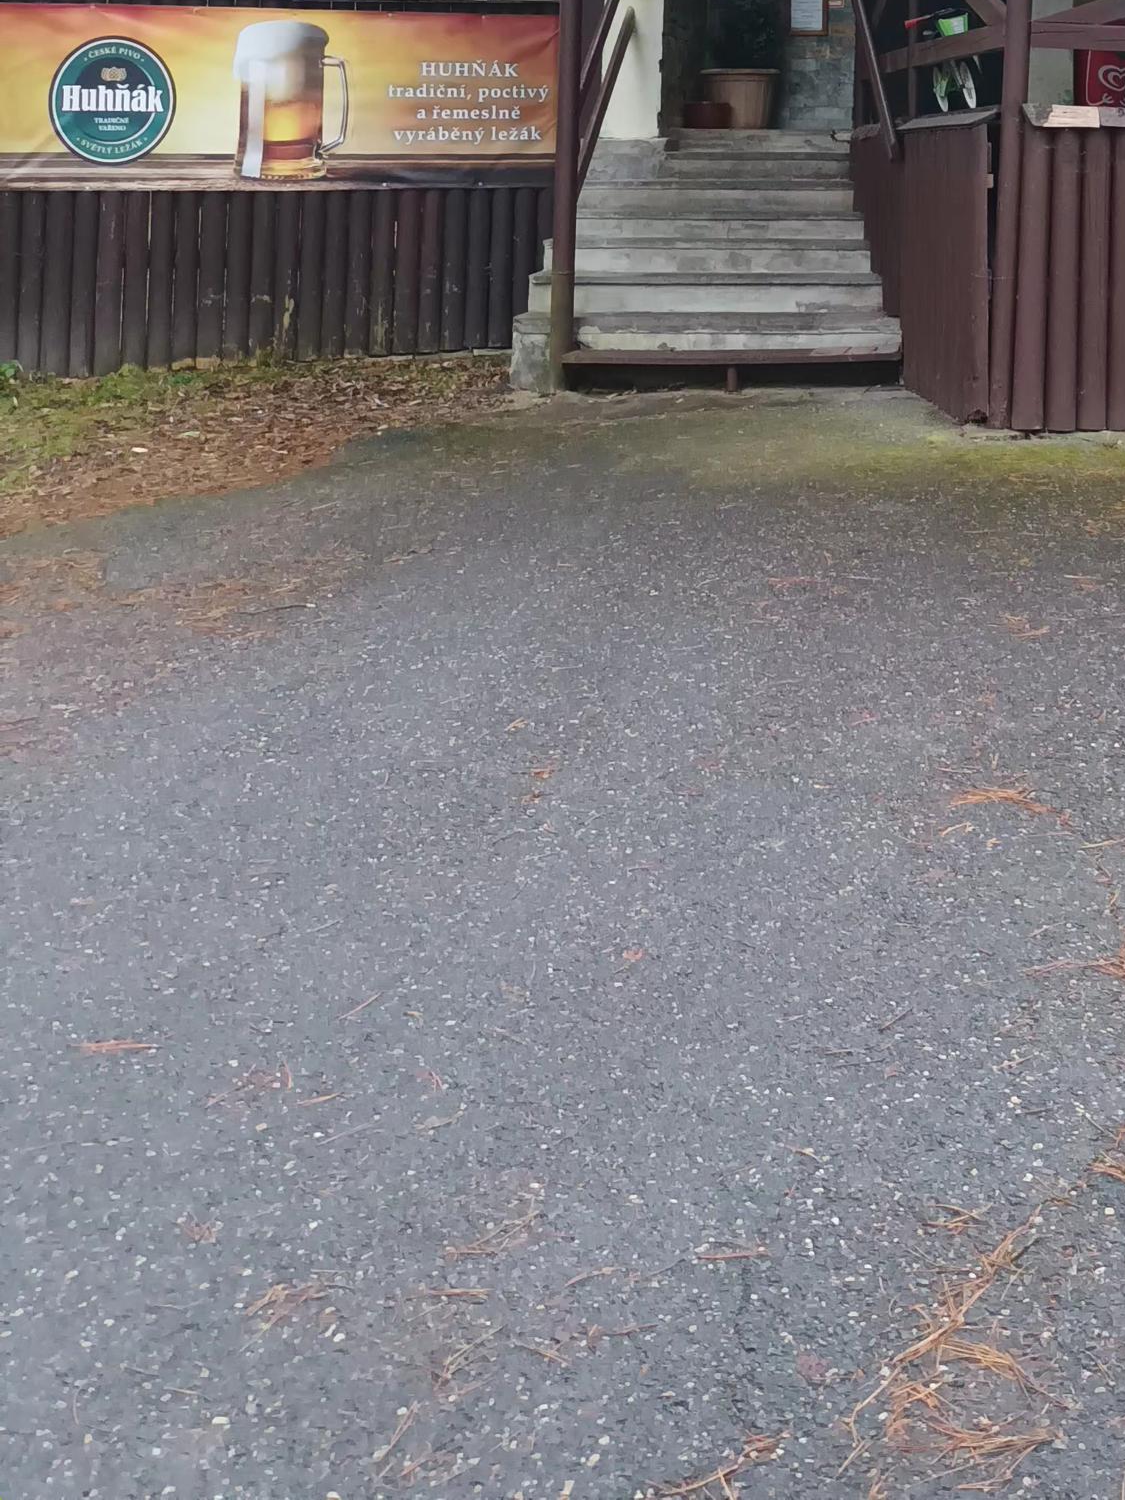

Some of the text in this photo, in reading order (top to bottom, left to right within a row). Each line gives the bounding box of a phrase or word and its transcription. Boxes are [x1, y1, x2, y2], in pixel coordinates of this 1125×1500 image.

[88, 46, 141, 59] ČESKÉ PIVO
[421, 60, 519, 77] HUHŇÁK
[62, 83, 164, 112] Huhňák
[388, 84, 549, 102] tradiční, poctivý
[416, 106, 521, 119] a řemeslně
[393, 126, 542, 145] vyráběný ležák
